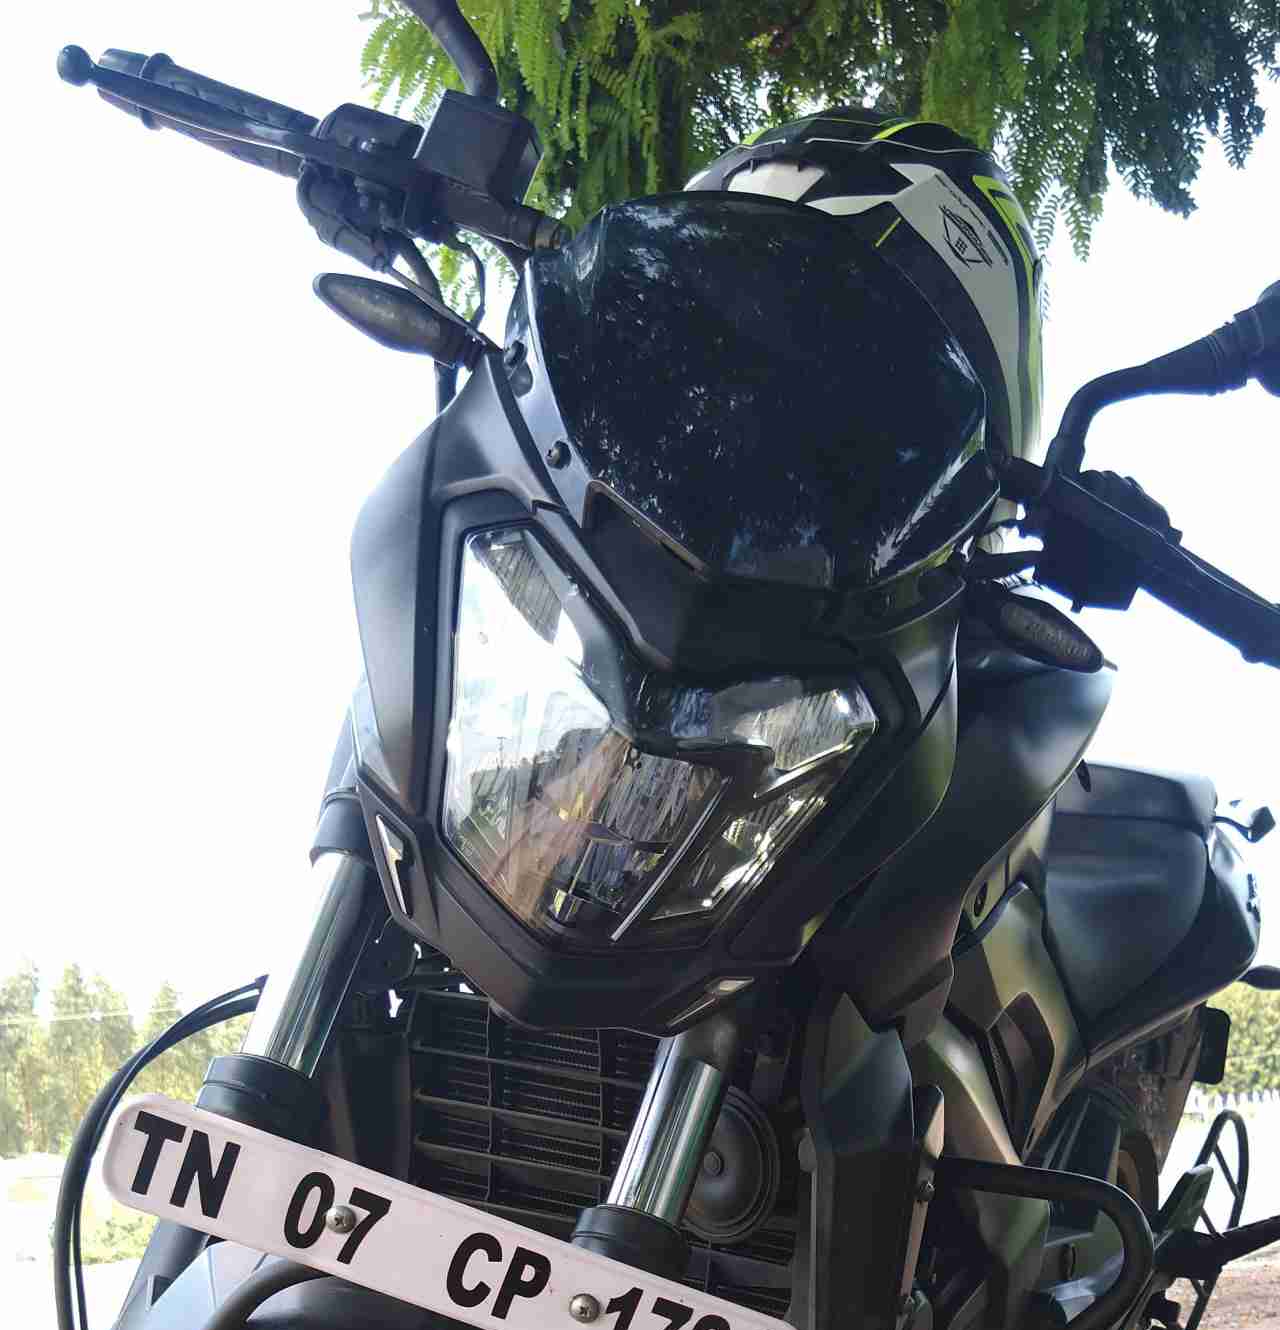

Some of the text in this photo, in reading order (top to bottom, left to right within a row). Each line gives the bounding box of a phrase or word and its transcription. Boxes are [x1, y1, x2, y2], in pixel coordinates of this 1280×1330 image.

[132, 1109, 241, 1219] TN
[283, 1171, 392, 1265] 07
[446, 1232, 552, 1320] CP
